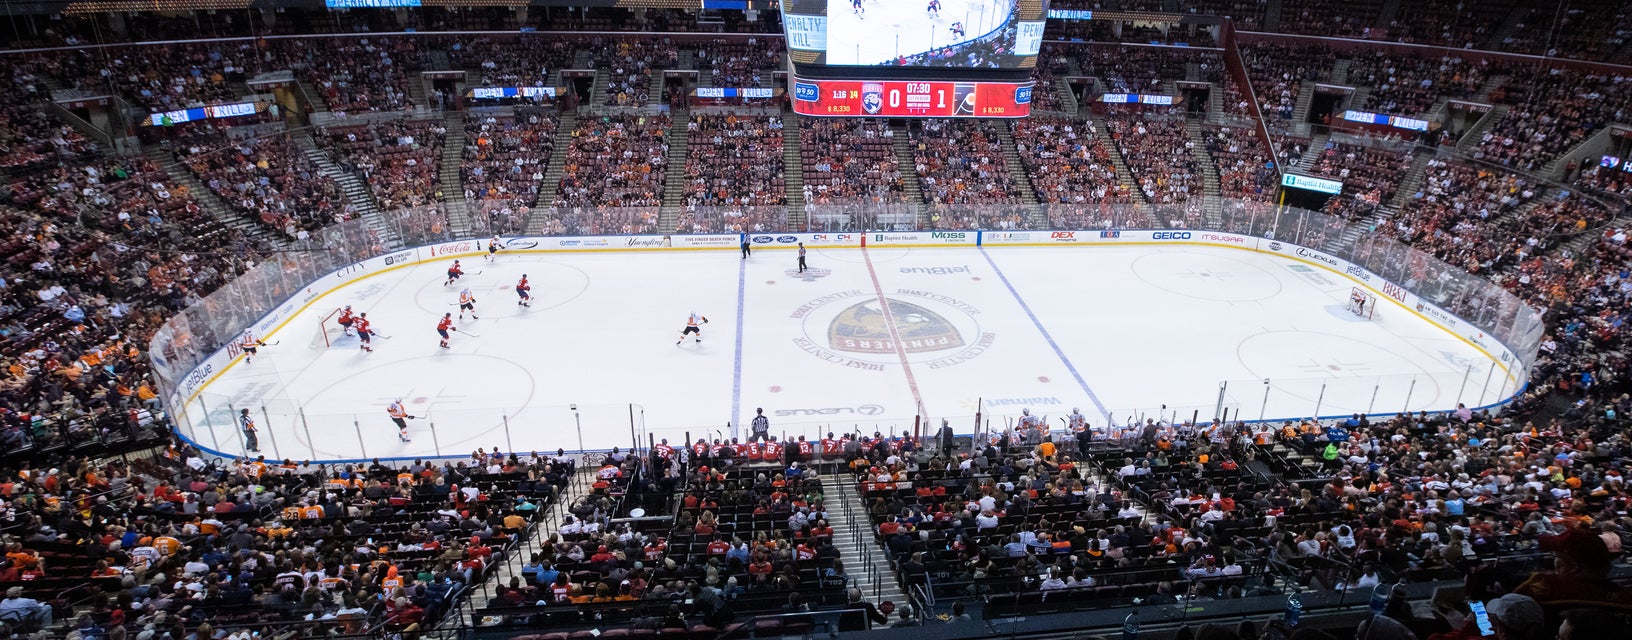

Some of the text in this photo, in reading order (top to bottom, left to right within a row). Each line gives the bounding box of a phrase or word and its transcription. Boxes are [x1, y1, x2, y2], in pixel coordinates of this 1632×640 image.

[792, 33, 811, 47] KILL
[833, 91, 858, 99] 1:16 14
[906, 83, 931, 93] 07:30
[889, 89, 900, 107] 0
[937, 90, 946, 108] 1
[1308, 252, 1338, 266] LEXUS
[899, 264, 971, 275] jetBlue
[1346, 265, 1371, 281] jetBlue
[1382, 281, 1407, 302] BB&T
[260, 314, 280, 332] Walmart
[844, 336, 948, 349] PANTHERS
[186, 363, 213, 392] jetBlue
[986, 396, 1062, 407] Walmart
[775, 407, 855, 416] LEXUS
[800, 445, 809, 453] 13
